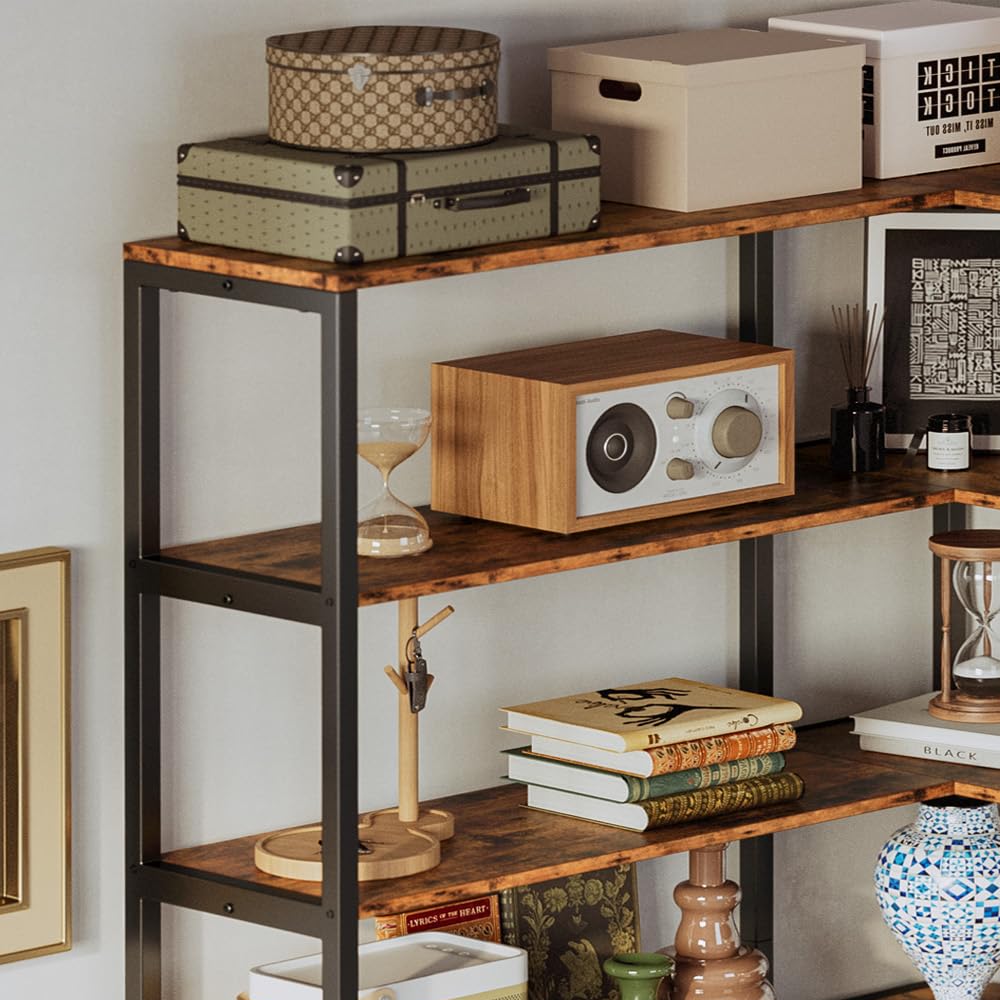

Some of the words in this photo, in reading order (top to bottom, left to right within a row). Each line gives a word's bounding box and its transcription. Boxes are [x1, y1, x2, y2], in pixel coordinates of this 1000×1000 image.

[923, 745, 978, 762] BLACK
[410, 915, 438, 928] LYRICS
[459, 904, 486, 917] HEART
